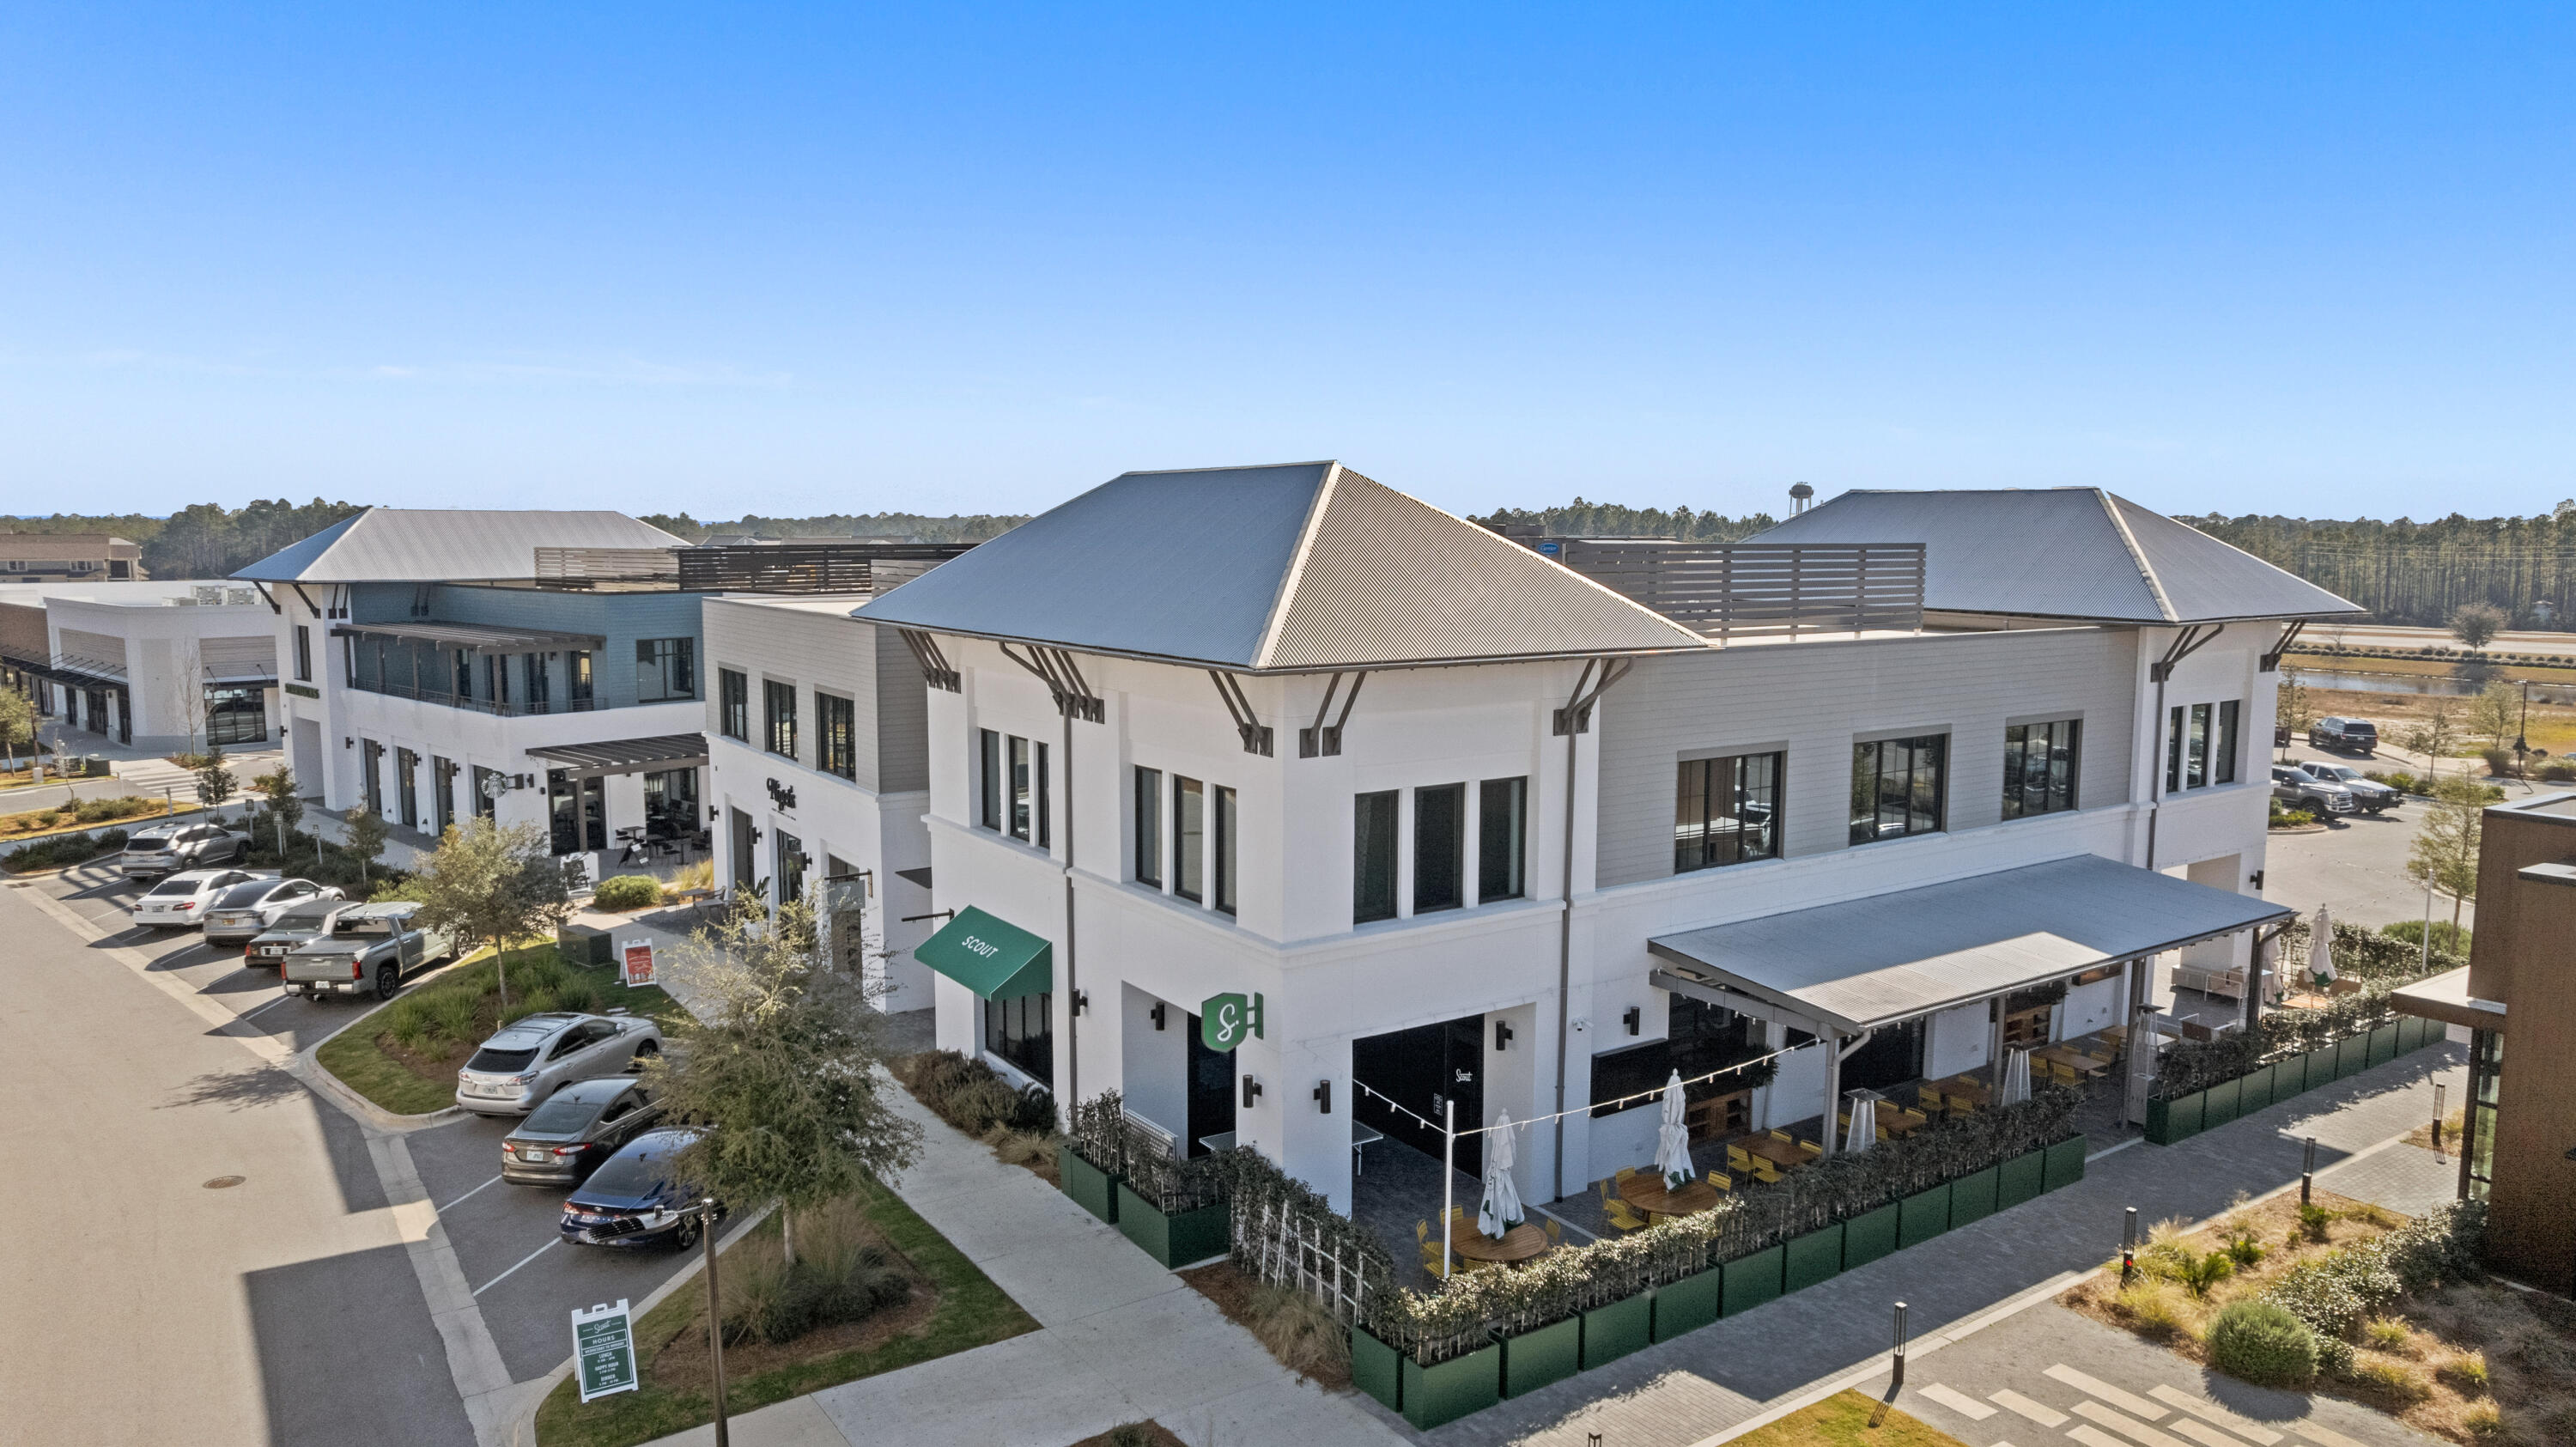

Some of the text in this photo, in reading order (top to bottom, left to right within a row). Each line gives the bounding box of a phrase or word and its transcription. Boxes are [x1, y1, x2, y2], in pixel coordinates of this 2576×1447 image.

[962, 935, 999, 958] SCOUT
[1455, 1067, 1473, 1082] Scout
[593, 1319, 611, 1334] Scout
[592, 1335, 616, 1345] HOURS
